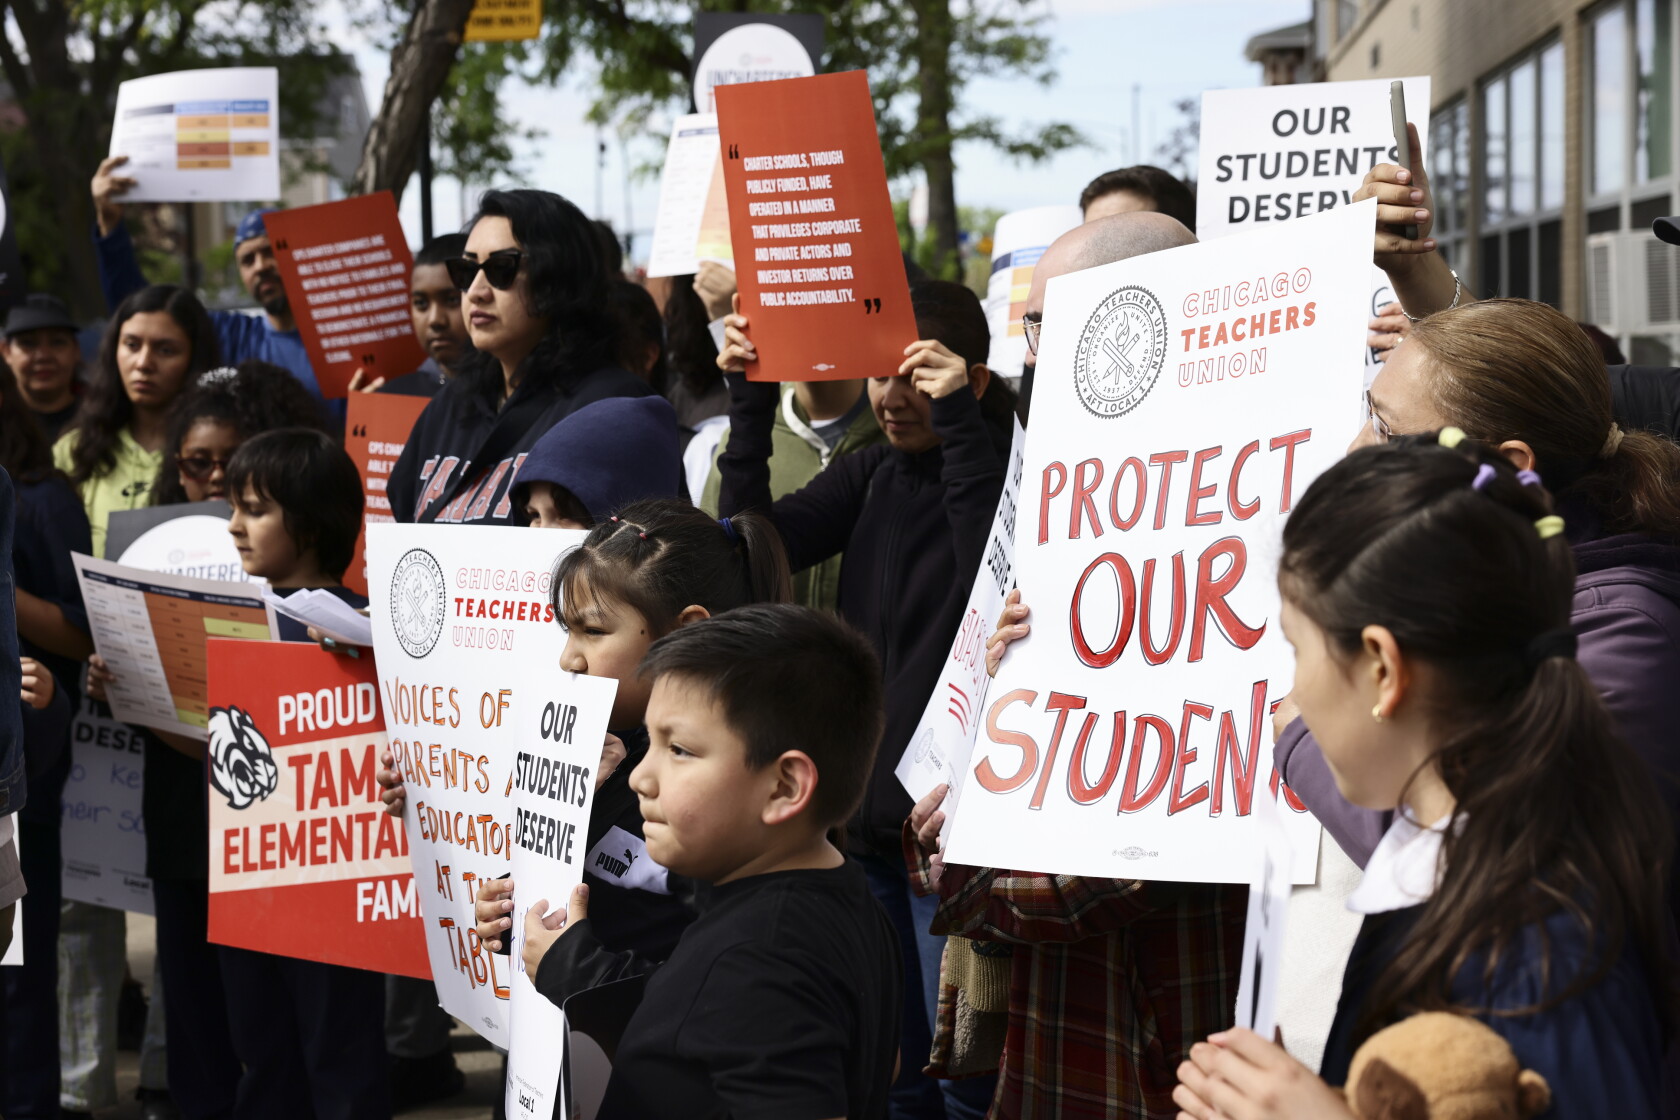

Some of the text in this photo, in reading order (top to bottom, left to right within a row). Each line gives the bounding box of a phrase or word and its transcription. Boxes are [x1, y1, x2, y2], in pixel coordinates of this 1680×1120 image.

[1272, 106, 1351, 137] OUR
[743, 150, 844, 171] CHARTER SCHOOLS, THOUGH
[746, 175, 832, 194] PUBLICLY FUNDED, HAVE
[749, 198, 835, 216] OPERATED IN A MANNER
[1228, 190, 1352, 223] DESER
[752, 219, 862, 239] THAT PRIVILEGES CORPORATE
[755, 242, 852, 261] AND PRIVATE ACTORS AND
[757, 265, 854, 284] INVESTOR RETURNS OVER
[760, 288, 856, 306] PUBLIC ACCOUNTABILITY.
[1182, 267, 1312, 318] CHICAGO
[1078, 292, 1163, 384] CHICAGO TEACHERS UNION
[1181, 301, 1317, 352] TEACHERS
[1178, 347, 1267, 388] UNION
[1086, 394, 1102, 410] AFT
[1104, 394, 1138, 413] LOCAL
[368, 441, 405, 456] CPS CHA
[367, 459, 388, 473] ABLE
[366, 495, 391, 509] TEACH
[1038, 428, 1312, 546] PROTECT
[392, 565, 404, 623] CHICAGO
[405, 552, 439, 577] TEACHERS
[456, 567, 553, 593] CHICAGO
[454, 597, 555, 623] TEACHERS
[1070, 535, 1268, 669] OUR
[411, 644, 430, 655] LOCAL
[452, 626, 514, 651] UNION
[278, 682, 376, 736] PROUD
[385, 676, 512, 729] VOICES OF
[75, 721, 142, 755] DESE
[540, 701, 578, 745] OUR
[974, 679, 1310, 818] STUDEN
[110, 761, 141, 789] Ke
[392, 738, 489, 794] PARENTS
[515, 751, 590, 808] STUDENTS
[60, 796, 112, 824] heir
[515, 807, 576, 865] DESERVE
[435, 859, 454, 901] AT
[439, 916, 511, 1000] TABL
[519, 1089, 531, 1110] Local
